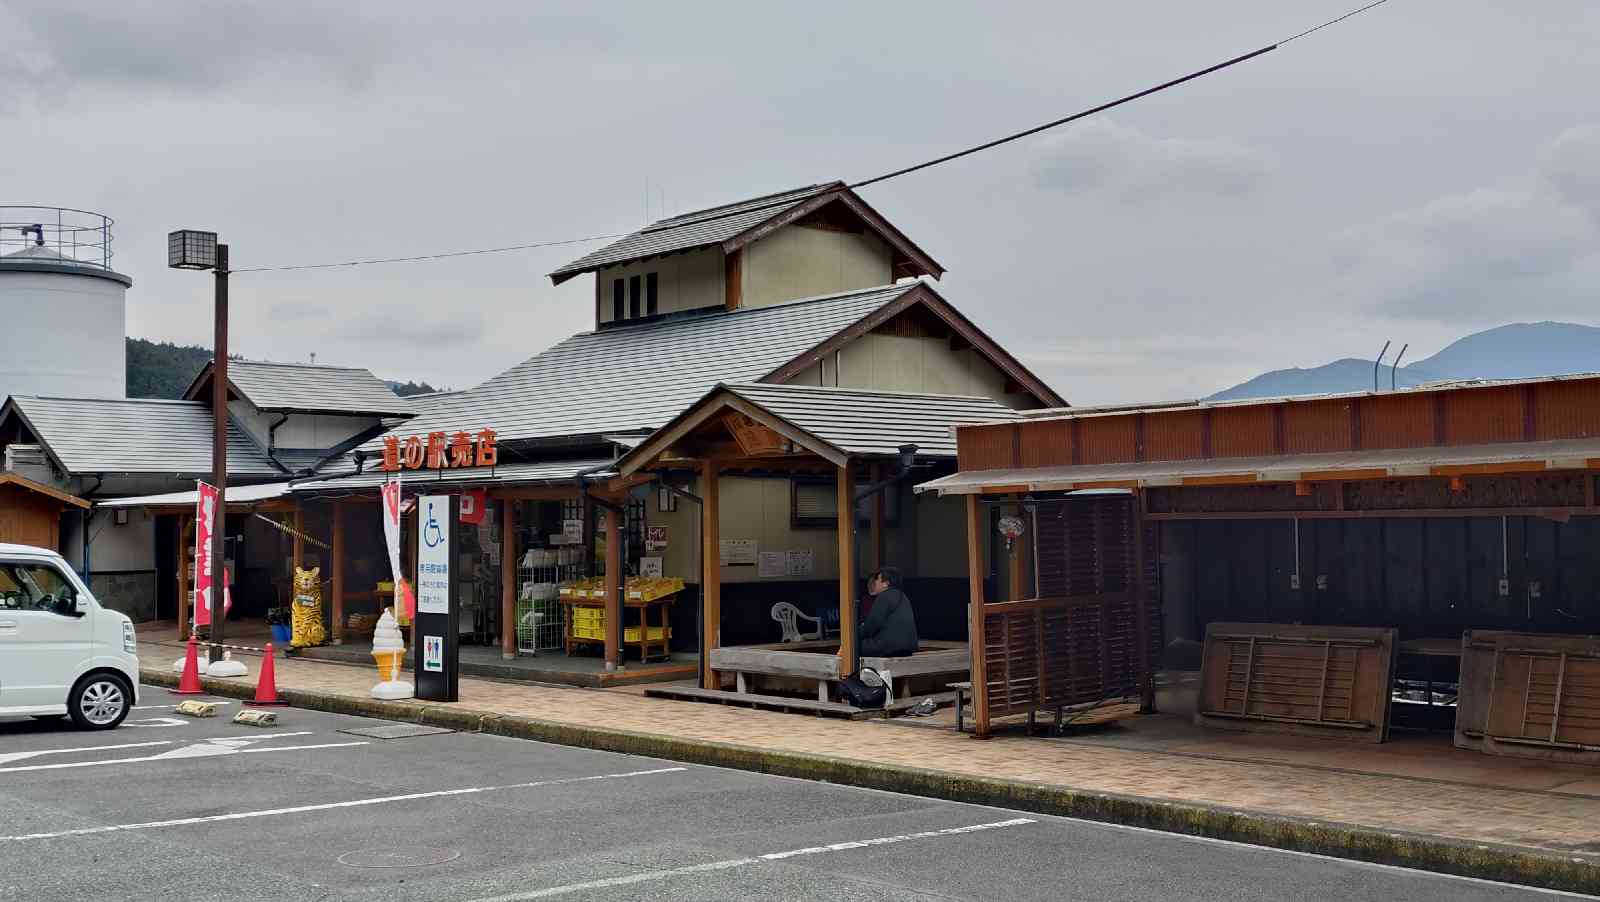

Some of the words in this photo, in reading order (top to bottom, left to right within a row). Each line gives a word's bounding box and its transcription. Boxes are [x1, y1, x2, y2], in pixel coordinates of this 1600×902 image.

[383, 427, 497, 471] 道の駅売店
